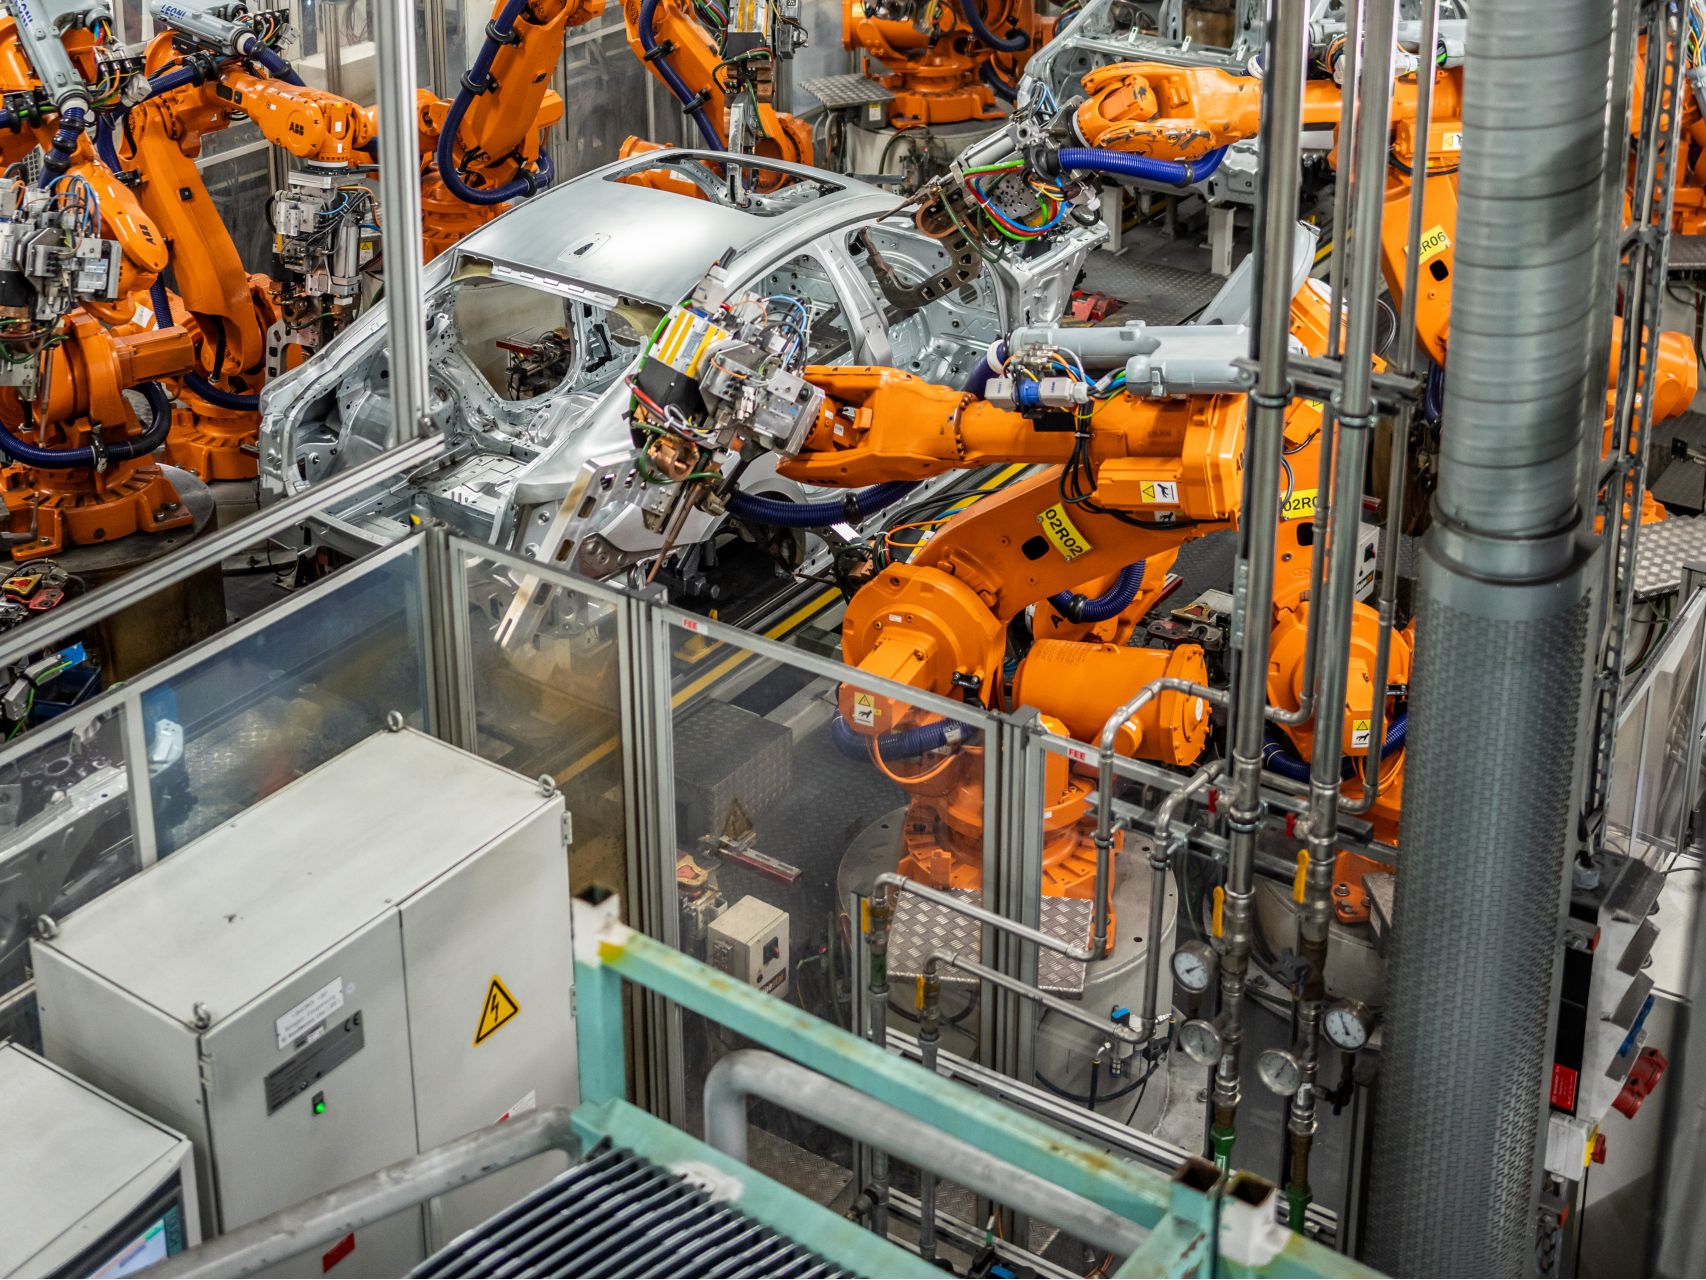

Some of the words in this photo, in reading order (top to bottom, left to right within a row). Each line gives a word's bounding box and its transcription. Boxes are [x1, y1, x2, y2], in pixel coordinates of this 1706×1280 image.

[160, 3, 187, 20] LEONI
[288, 121, 305, 137] ABB
[138, 223, 157, 246] ABB
[1283, 495, 1320, 512] 02R0
[1045, 508, 1085, 557] 02R02
